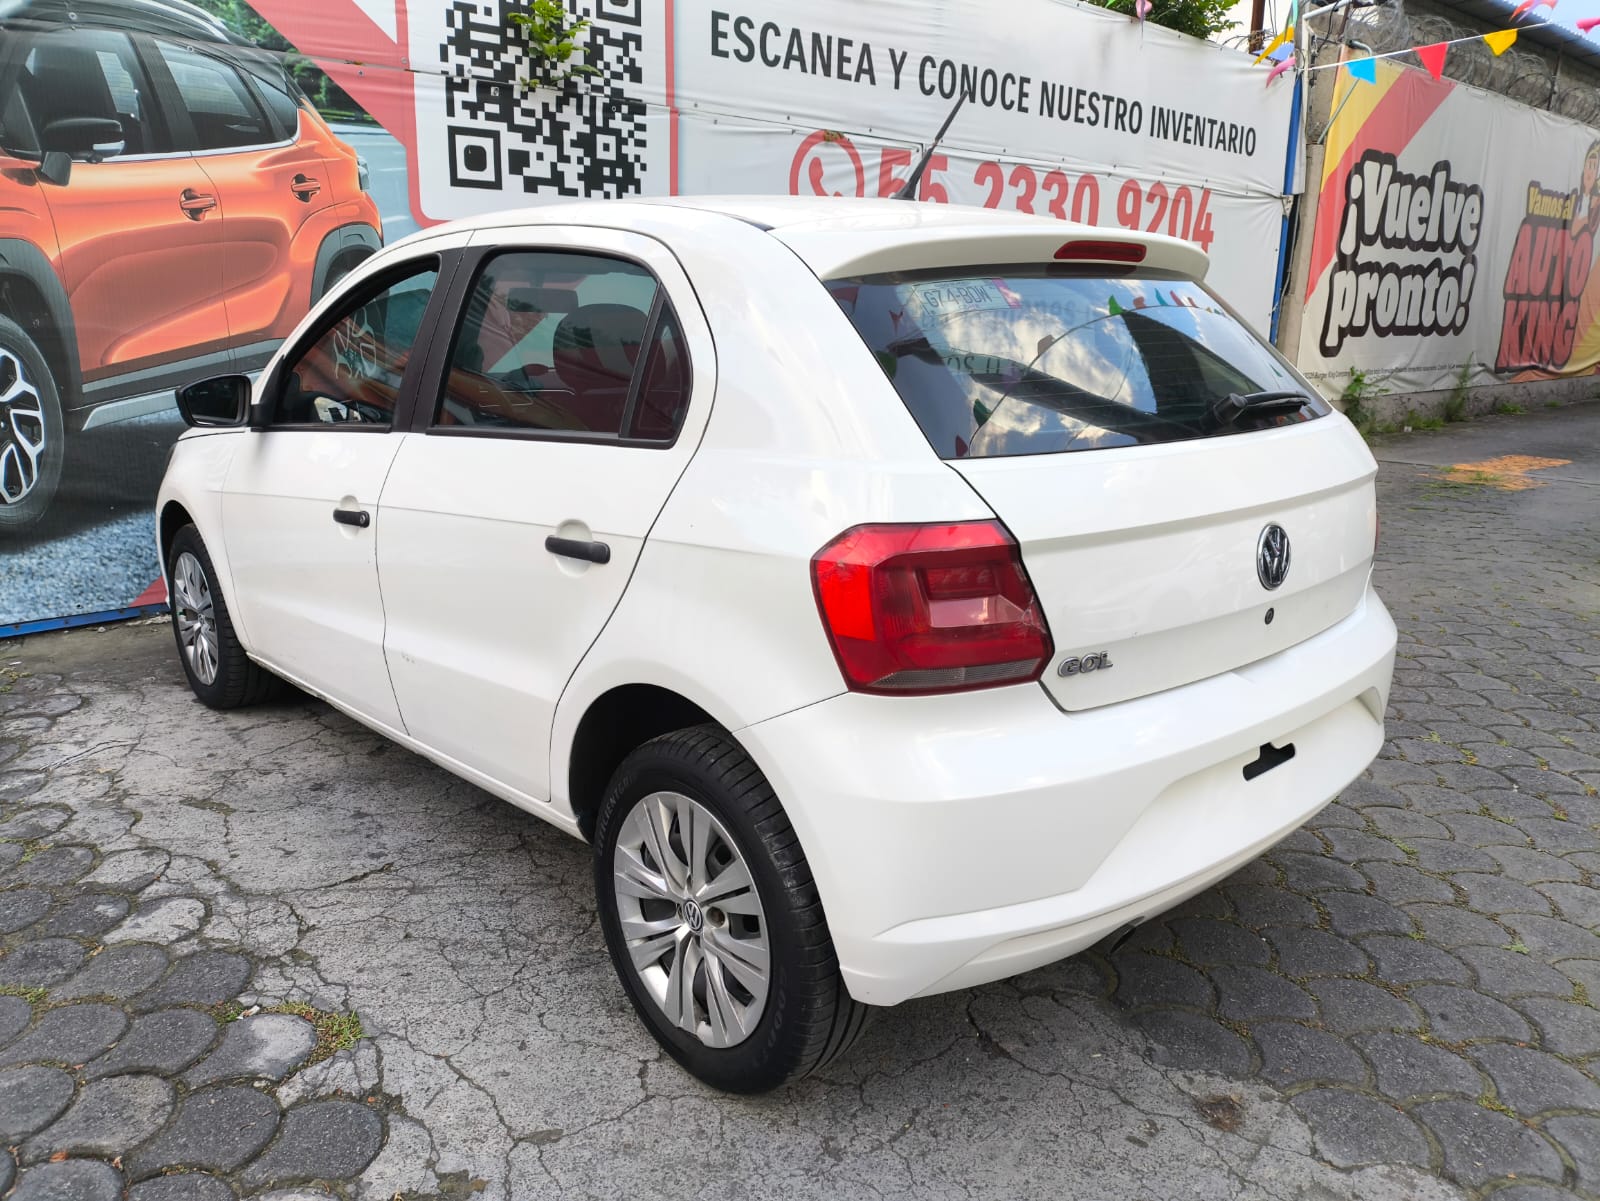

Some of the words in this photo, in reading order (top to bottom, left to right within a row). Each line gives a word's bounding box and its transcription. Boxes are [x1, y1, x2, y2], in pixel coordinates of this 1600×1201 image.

[711, 10, 876, 86] ESCANEA
[888, 48, 908, 90] Y
[918, 55, 1031, 113] CONOCE
[1039, 81, 1143, 134] NUESTRO
[1150, 105, 1256, 157] INVENTARIO
[974, 161, 1100, 227] 2330
[1117, 179, 1214, 253] 9204
[1338, 151, 1484, 257] ¡Vuelve
[1528, 185, 1564, 218] Vamos
[1562, 193, 1577, 220] al
[1504, 223, 1592, 298] AUTO
[1321, 256, 1478, 355] pronto!
[1497, 300, 1579, 369] KING
[1058, 651, 1113, 677] GOL
